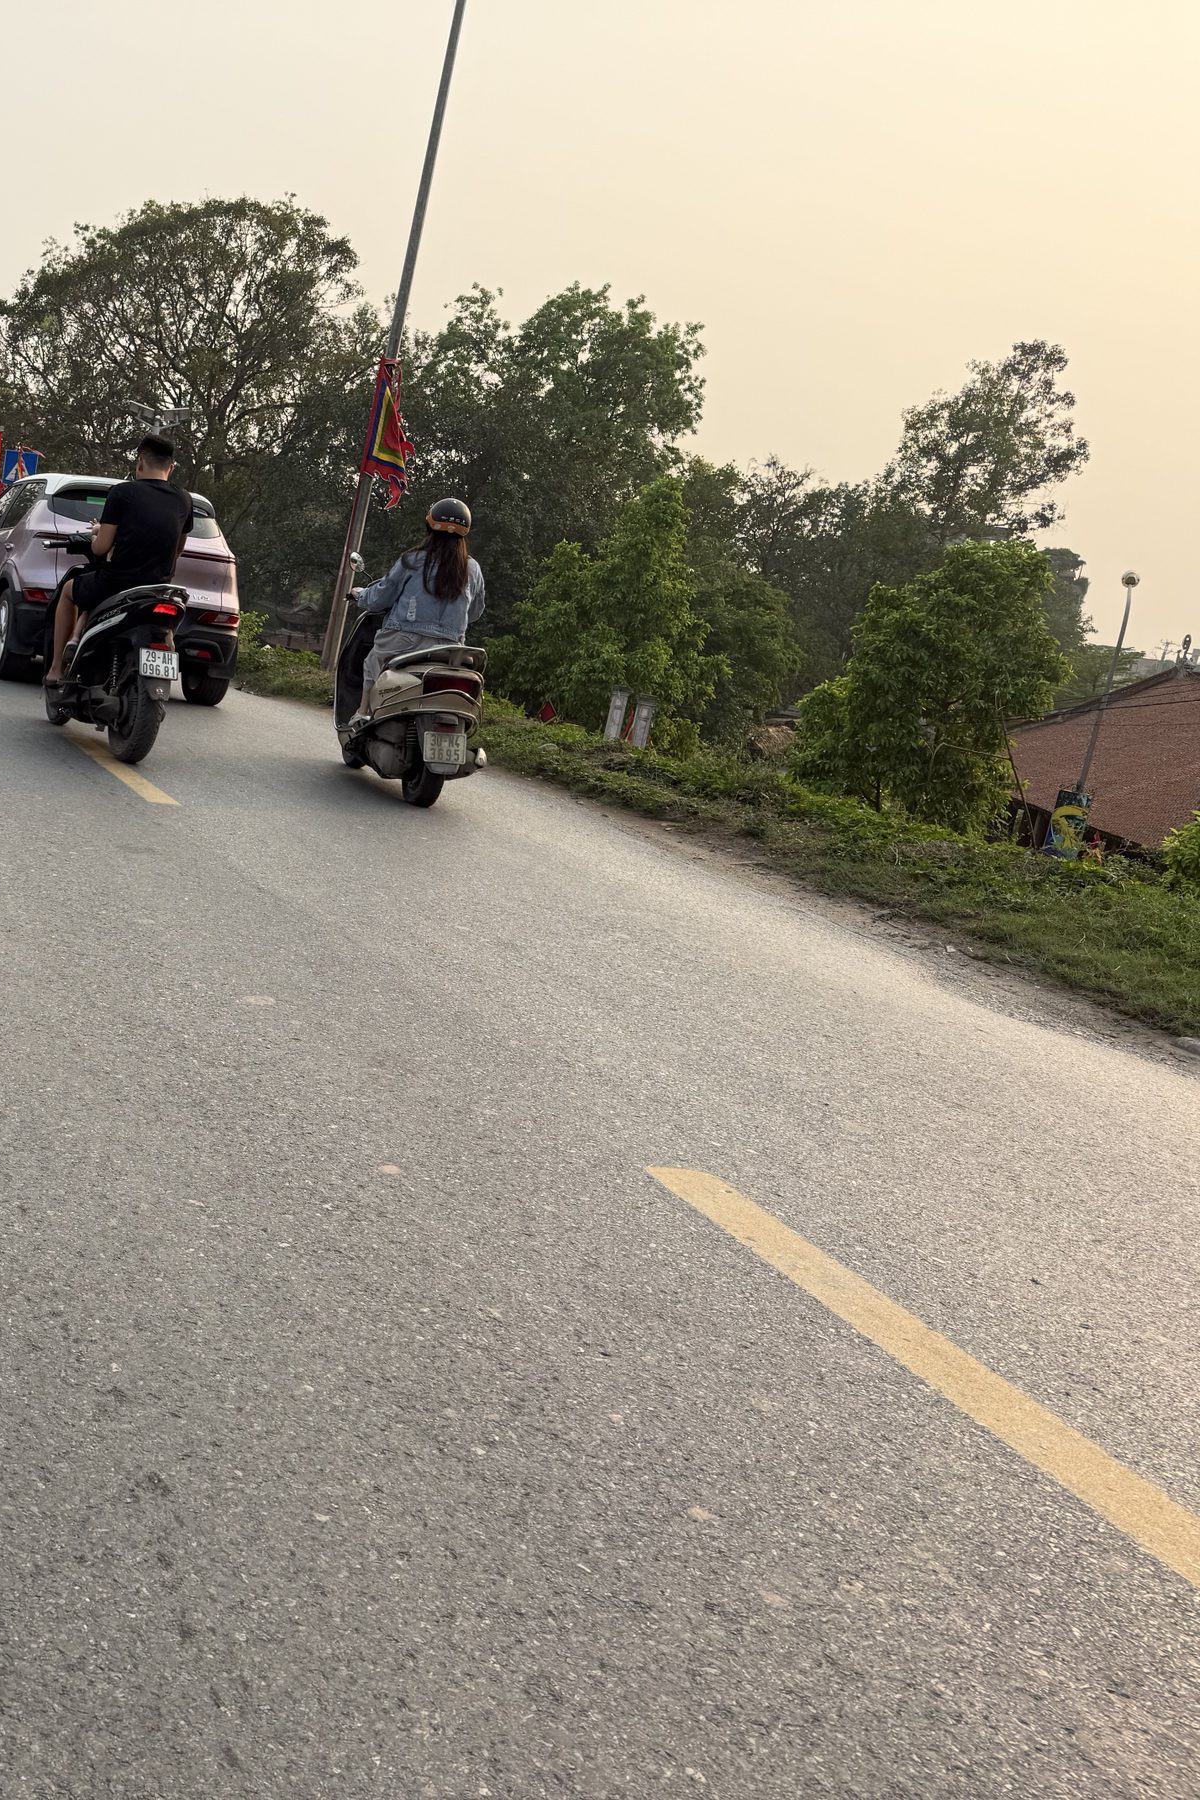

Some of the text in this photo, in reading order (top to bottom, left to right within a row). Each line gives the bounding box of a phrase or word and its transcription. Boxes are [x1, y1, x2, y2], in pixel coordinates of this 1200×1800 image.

[145, 651, 173, 665] 29-AH
[142, 663, 175, 678] 096.81
[430, 748, 460, 761] 3695
